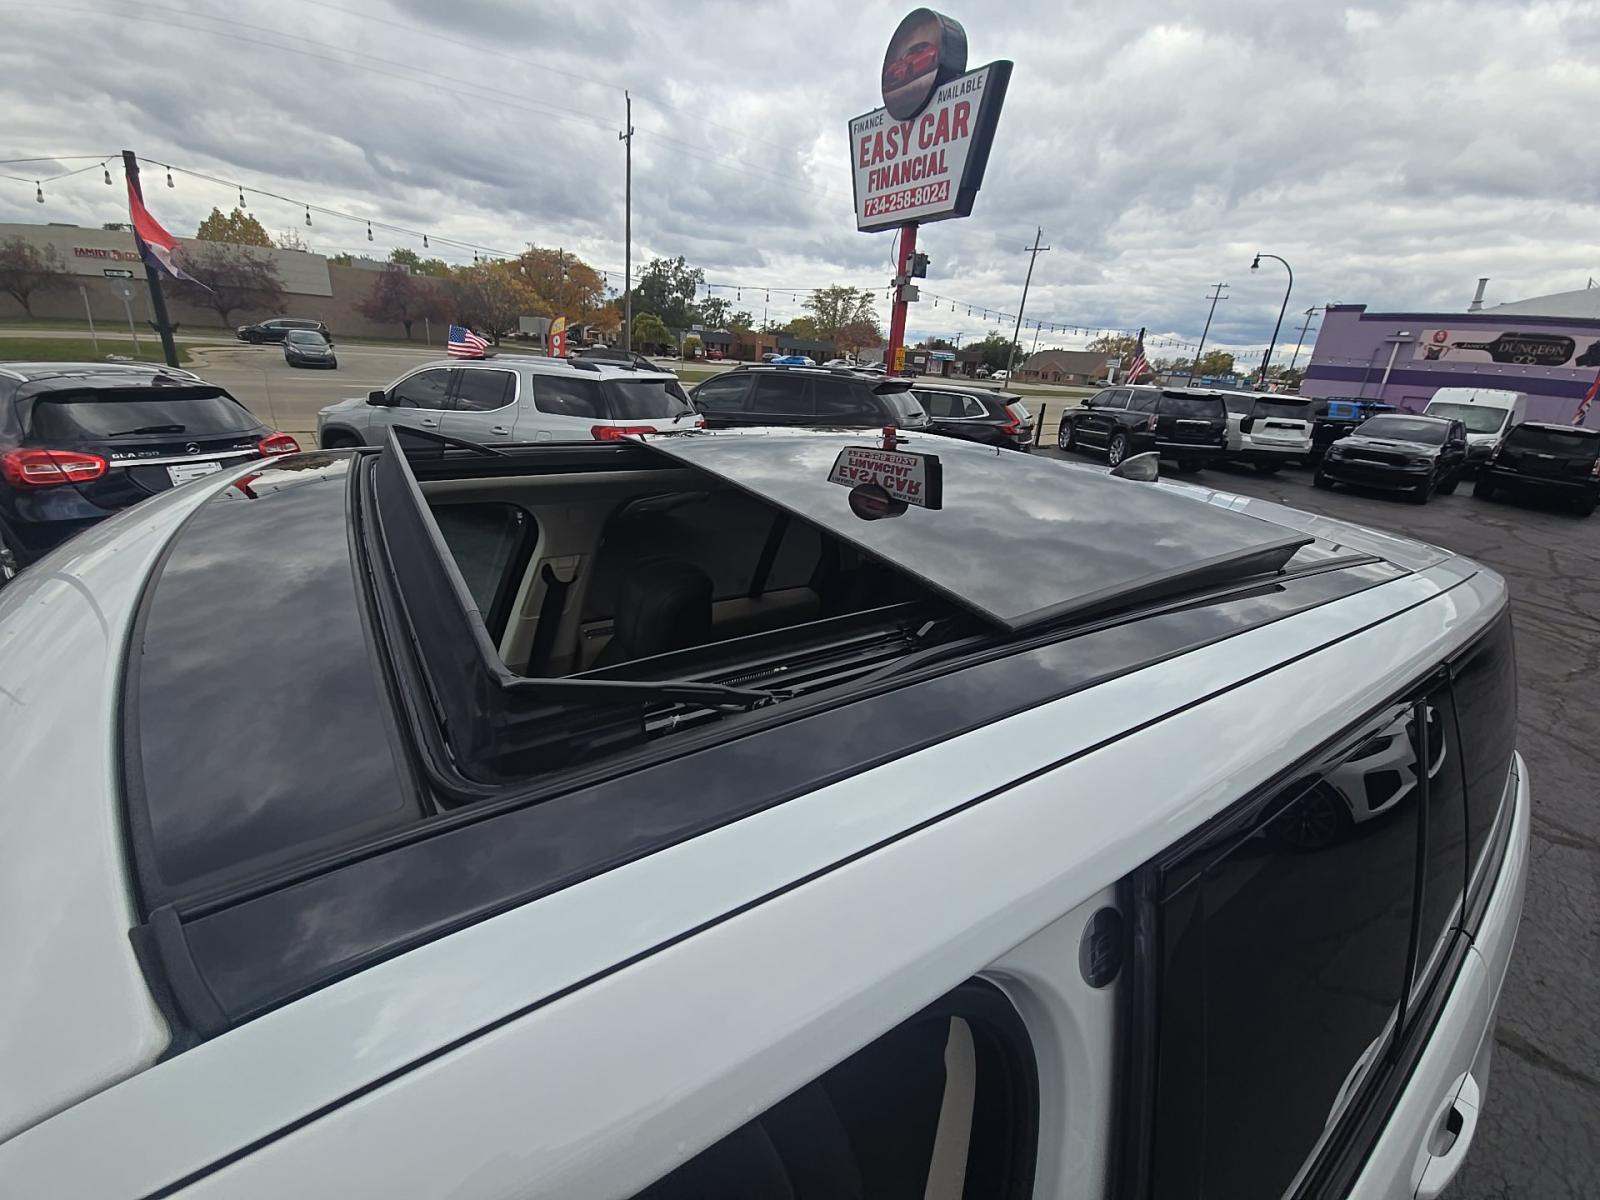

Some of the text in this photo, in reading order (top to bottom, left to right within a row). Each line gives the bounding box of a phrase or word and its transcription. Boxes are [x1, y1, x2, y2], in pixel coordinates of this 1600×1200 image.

[853, 75, 984, 135] FINANCE AVAILABLE
[859, 100, 971, 169] EASY CAR
[868, 149, 948, 193] FINANCIAL
[865, 183, 949, 216] 734-258-8024
